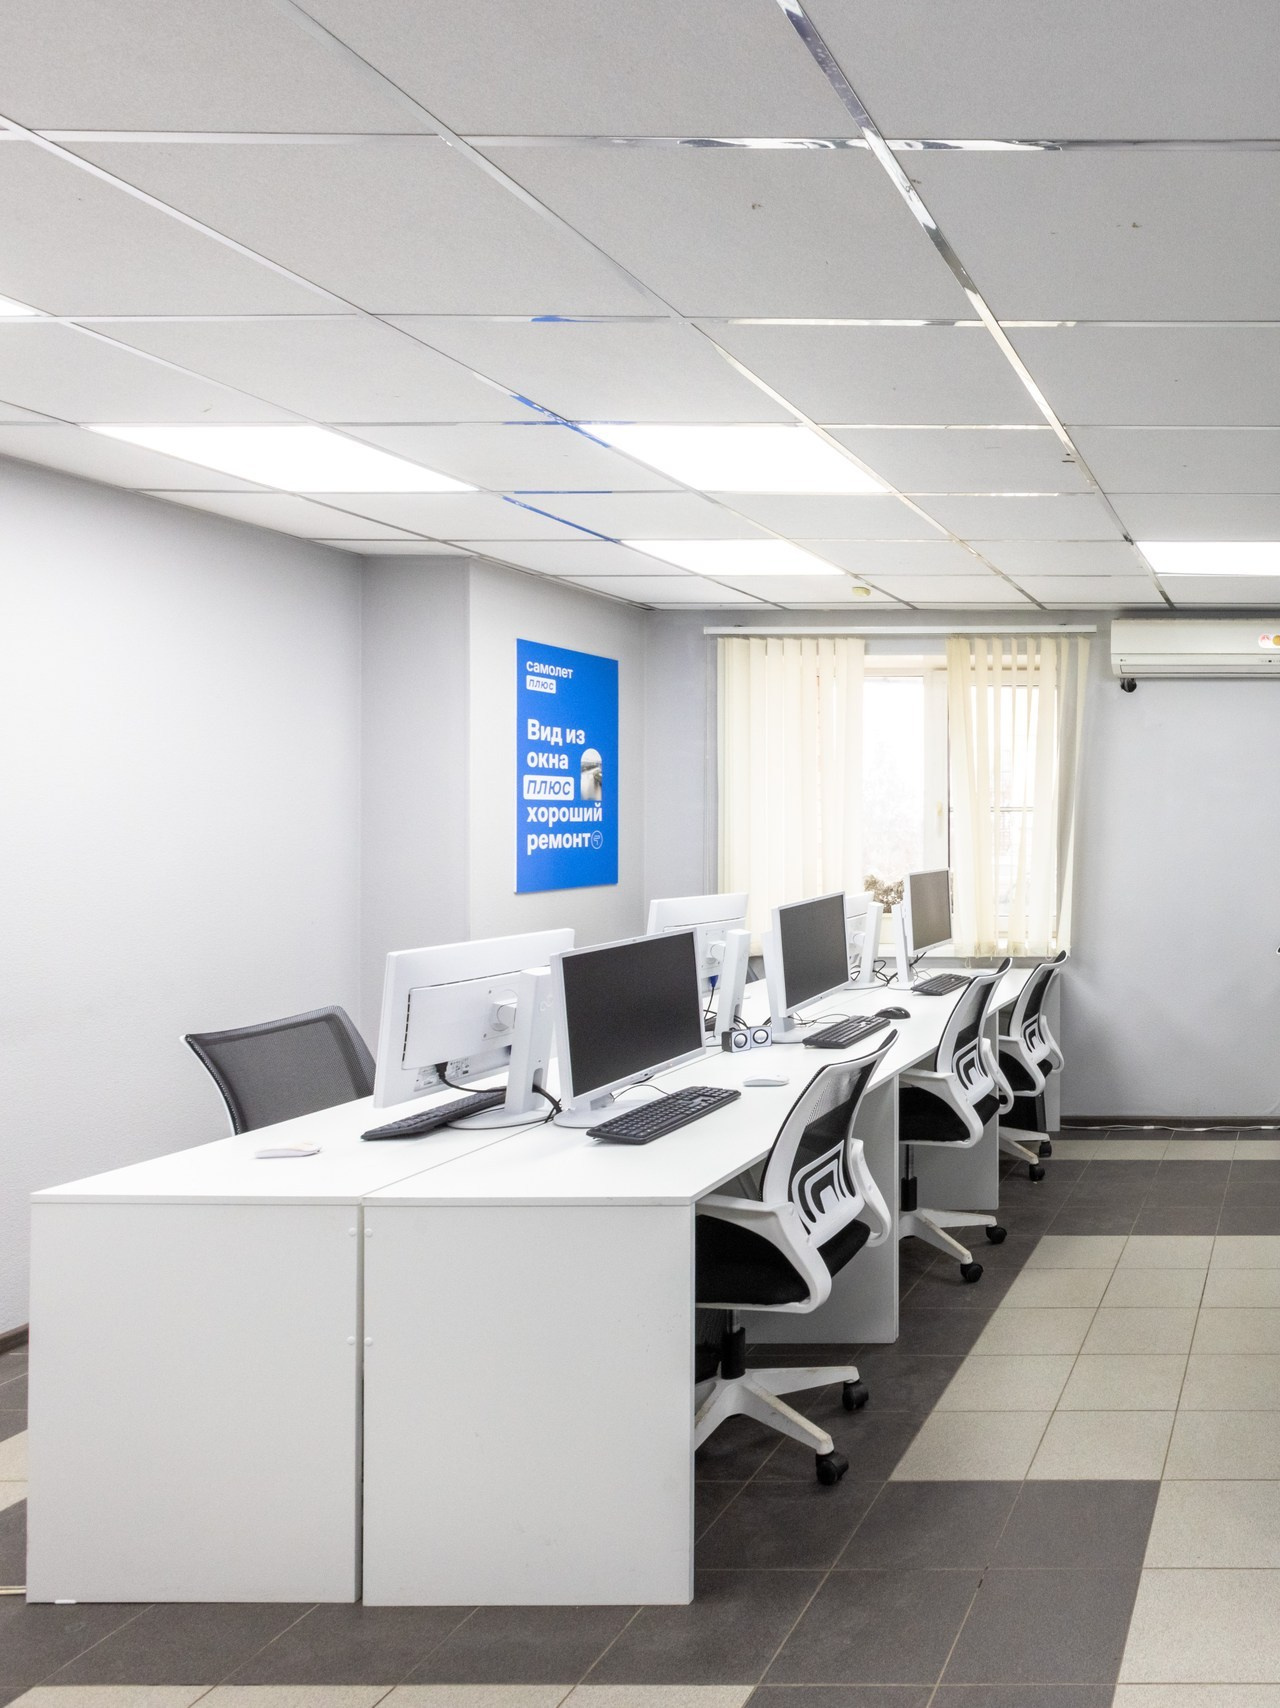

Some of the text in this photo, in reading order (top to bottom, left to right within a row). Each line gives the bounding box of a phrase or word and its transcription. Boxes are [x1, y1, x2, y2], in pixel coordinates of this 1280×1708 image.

[526, 660, 573, 679] самолет
[526, 718, 586, 746] Вид из
[526, 751, 569, 770] окна
[526, 802, 603, 827] хороший
[527, 831, 591, 855] ремонт
